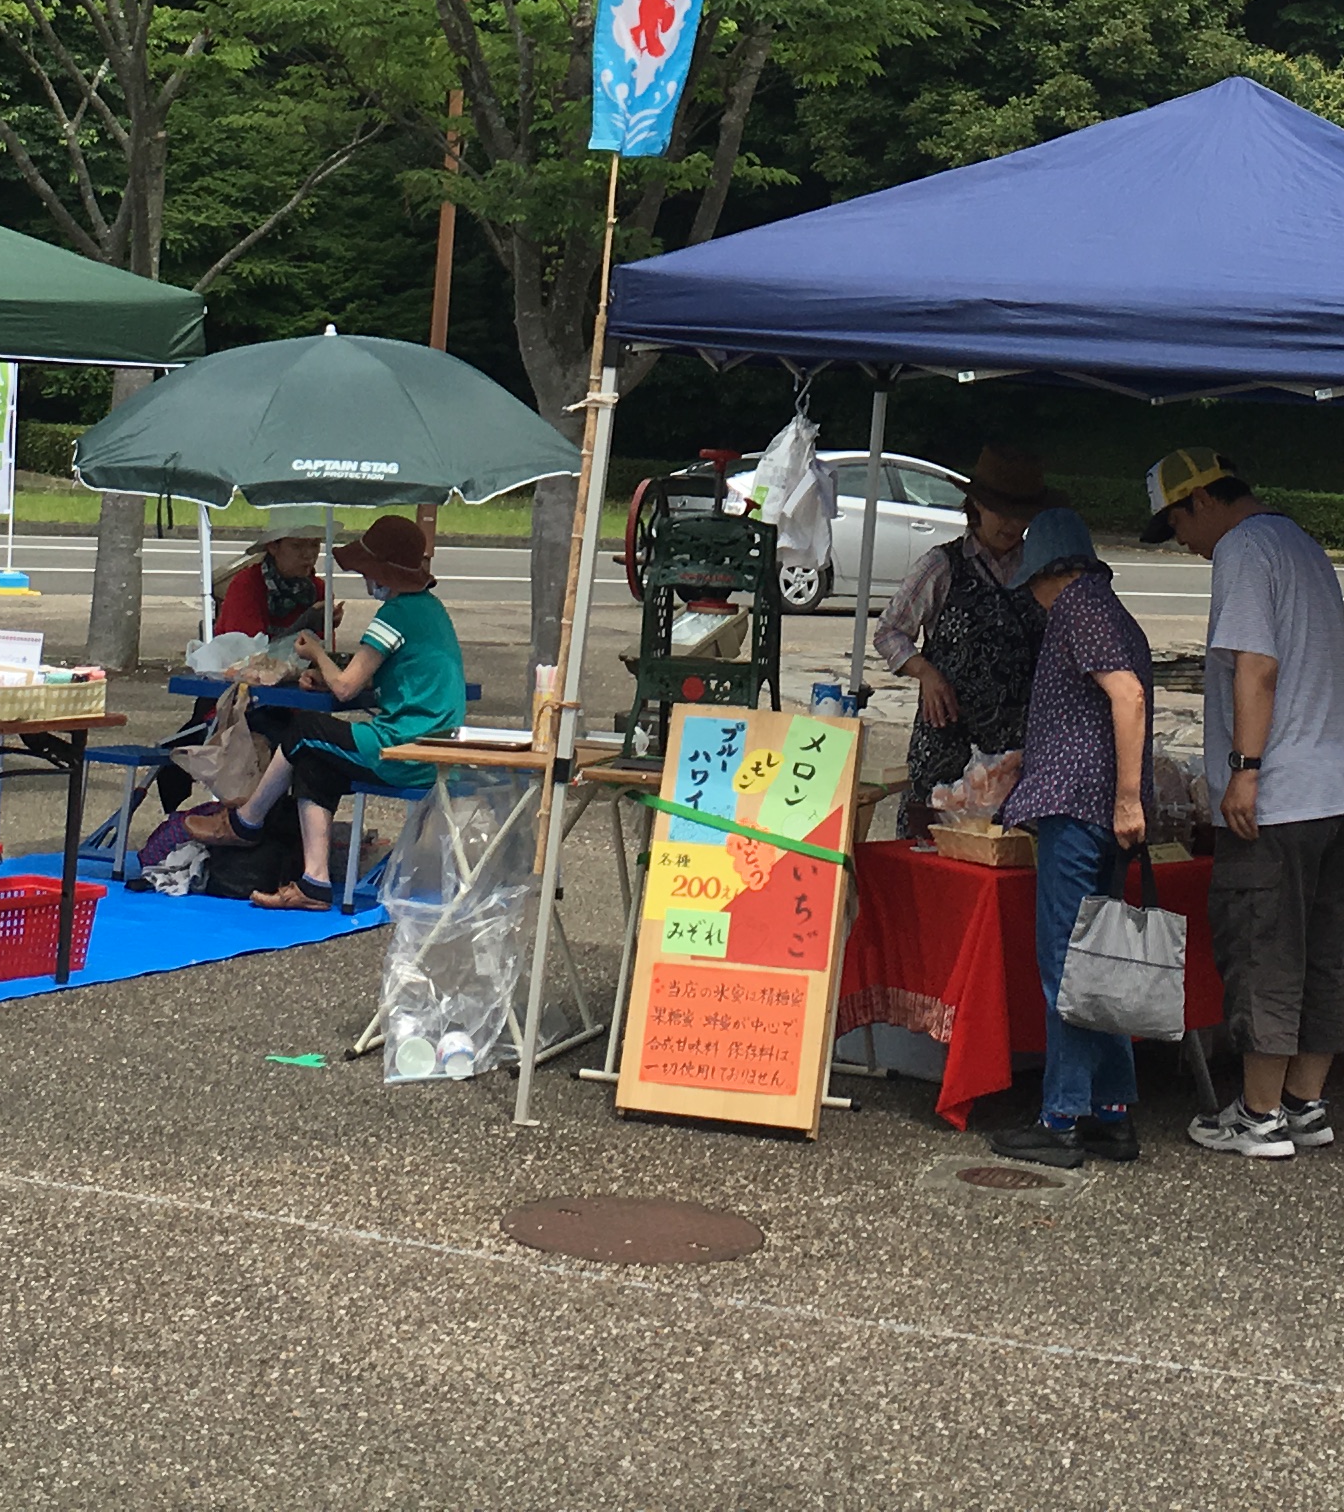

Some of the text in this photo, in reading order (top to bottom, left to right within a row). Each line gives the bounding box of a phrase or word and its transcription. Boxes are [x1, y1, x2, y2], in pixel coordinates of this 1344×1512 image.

[292, 459, 399, 474] CAPTAIN STAG
[323, 471, 385, 480] PROTECTION
[716, 721, 746, 772] ブルー
[685, 750, 712, 809] ハワイ
[739, 752, 780, 789] レモン
[784, 733, 826, 806] メロン
[657, 852, 691, 868] 各種
[670, 874, 739, 900] 200え
[787, 865, 818, 958] いちご
[666, 919, 725, 946] みぞれ
